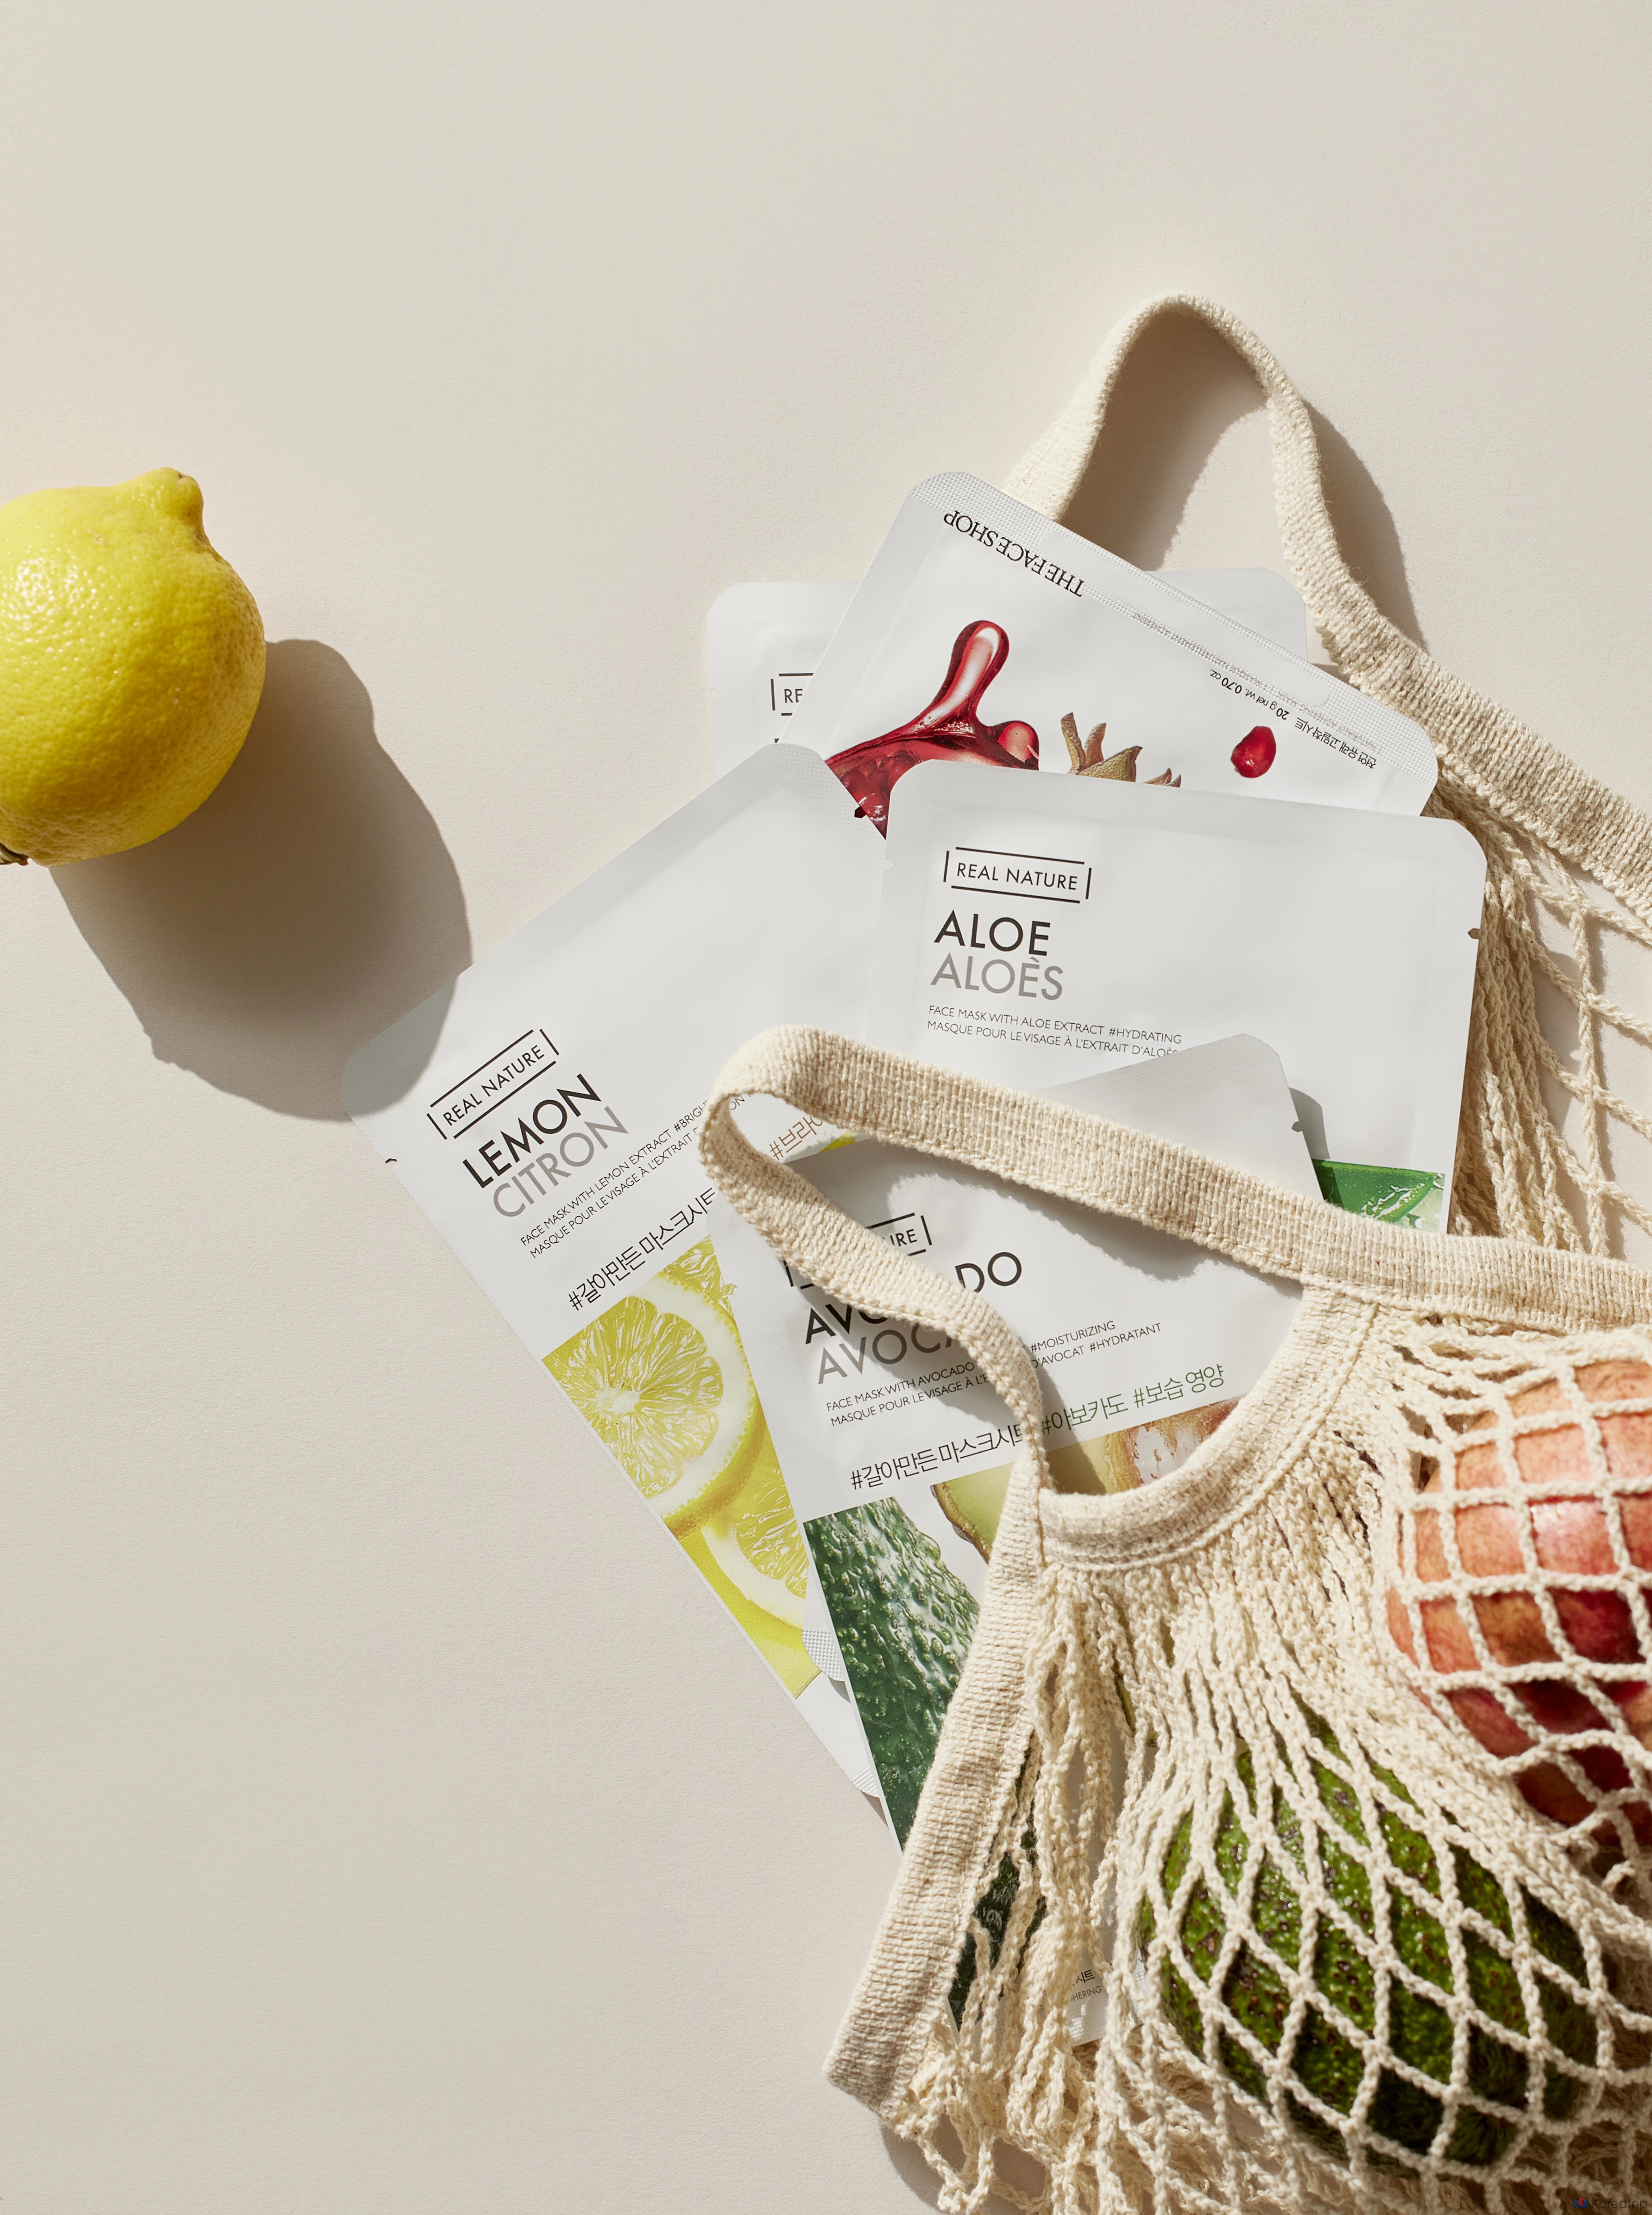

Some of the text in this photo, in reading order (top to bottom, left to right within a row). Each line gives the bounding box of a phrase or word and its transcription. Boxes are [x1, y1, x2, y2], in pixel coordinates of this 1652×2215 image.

[943, 510, 1084, 597] THE FACE SHOP
[1210, 669, 1221, 680] oz.
[1221, 678, 1242, 694] 0.70
[1245, 688, 1255, 699] wt.
[784, 688, 803, 703] RE
[1256, 696, 1269, 706] net
[1269, 701, 1277, 710] g
[1276, 708, 1290, 720] 20
[1294, 717, 1314, 734] 시트
[1338, 741, 1358, 759] 유래
[1357, 752, 1376, 769] 천연
[957, 862, 1078, 890] REAL NATURE
[933, 910, 1051, 956] ALOE
[930, 952, 1063, 1001] ALOÈS
[927, 1020, 973, 1035] MASQUE
[976, 1026, 1007, 1039] POUR
[1010, 1031, 1022, 1041] LE
[1024, 1032, 1061, 1046] VISAGE
[1064, 1035, 1072, 1047] À
[1076, 1039, 1129, 1053] L'EXTRAIT
[929, 1005, 1181, 1044] FACE MASK WITH ALOE EXTRACT #HYDRATING
[442, 1045, 544, 1126] REAL NATURE
[462, 1073, 602, 1189] LEMON
[493, 1106, 629, 1217] CITRON
[520, 1225, 545, 1246] FACE
[543, 1206, 571, 1229] MASK
[567, 1187, 595, 1209] WITH
[594, 1161, 630, 1191] LEMON
[629, 1128, 671, 1165] EXTRACT
[530, 1133, 692, 1259] MASQUE POUR LE VISAGE À L'EXTRAIT
[568, 1246, 646, 1311] #갈아만든
[826, 1397, 853, 1412] FACE
[855, 1388, 885, 1404] MASK
[884, 1378, 915, 1394] WITH
[918, 1362, 975, 1386] AVOCADO
[1030, 1321, 1116, 1353] #MOISTURIZING
[831, 1406, 877, 1427] MASQUE
[879, 1397, 911, 1413] POUR
[912, 1392, 925, 1403] LE
[924, 1381, 963, 1399] VISAGE
[965, 1376, 974, 1389] À
[1090, 1322, 1161, 1352] #HYDRATANT
[851, 1448, 938, 1490] #갈아만든
[1042, 1393, 1129, 1435] #아보카도
[1133, 1378, 1184, 1408] #보습
[1185, 1364, 1224, 1393] 영양
